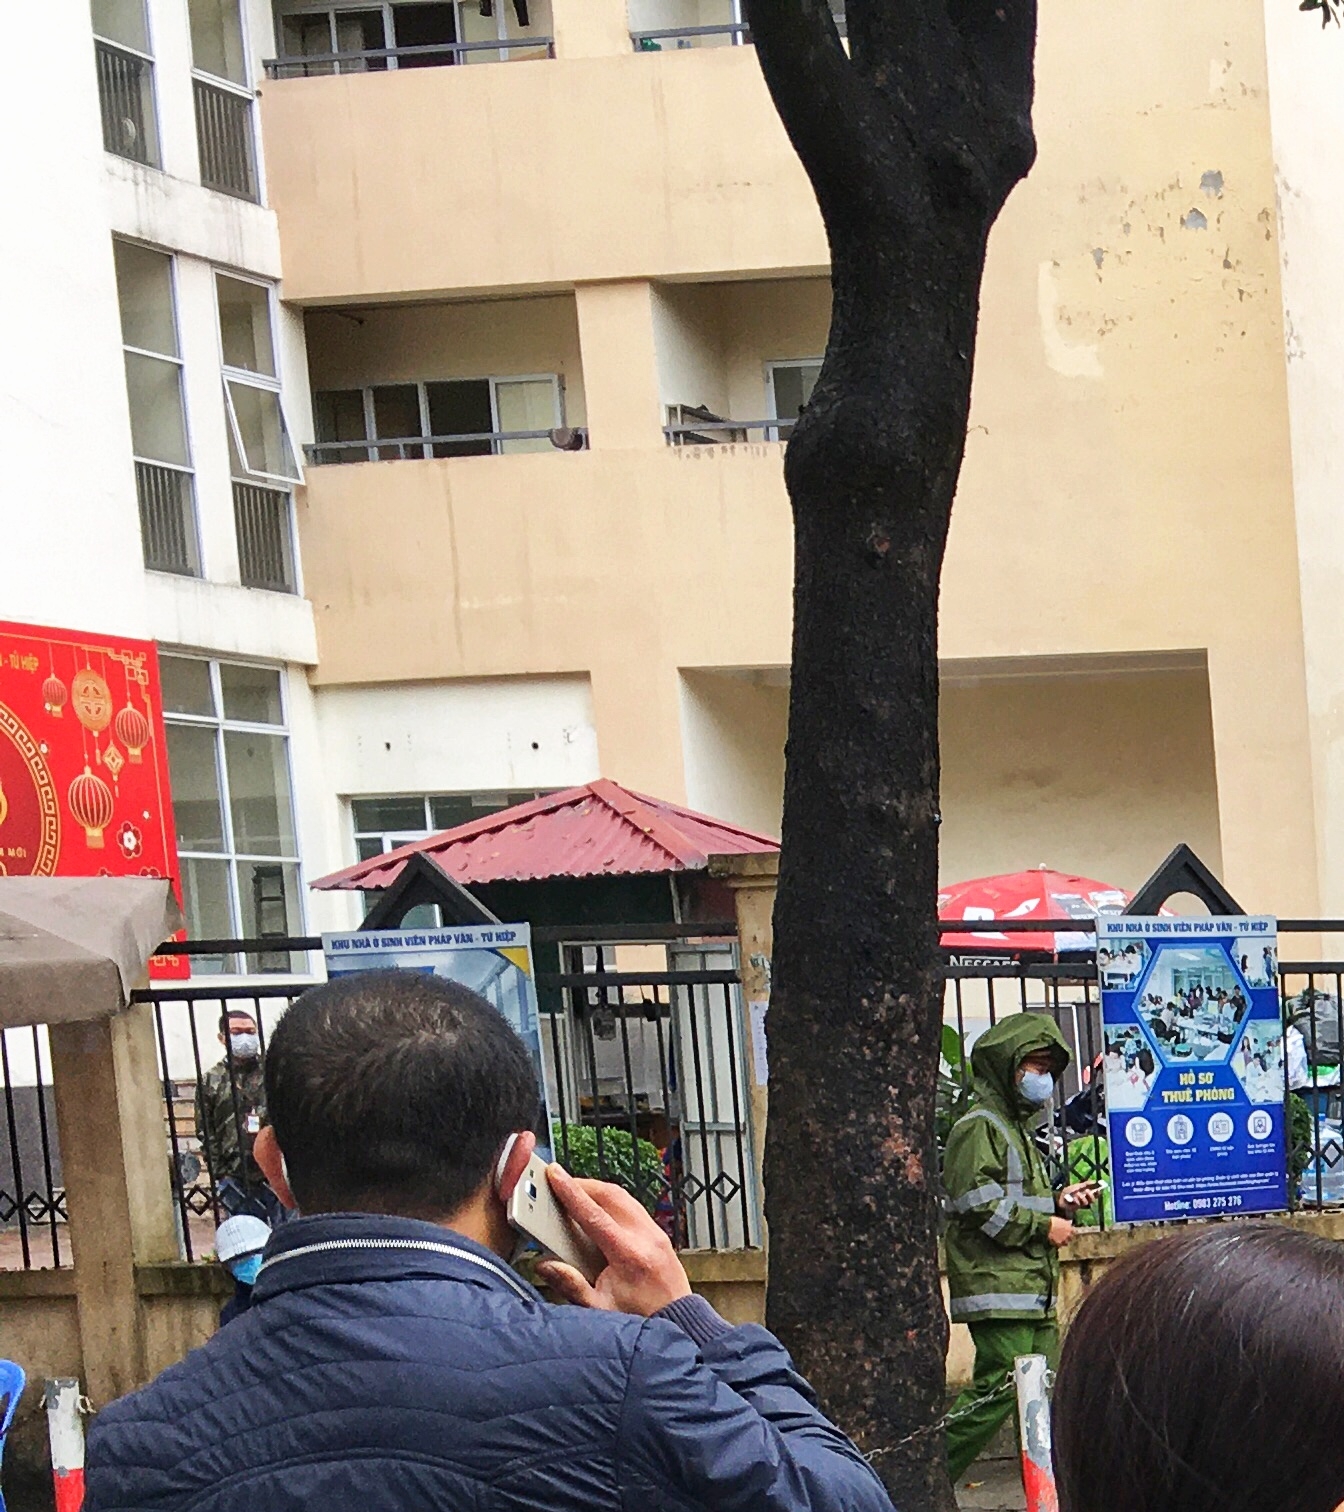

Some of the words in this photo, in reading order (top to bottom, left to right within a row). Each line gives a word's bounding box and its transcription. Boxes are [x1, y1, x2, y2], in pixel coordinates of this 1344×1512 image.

[1107, 923, 1123, 932] KHU
[1152, 923, 1171, 932] SINH
[1173, 921, 1192, 932] VIÊN
[331, 939, 350, 950] KHU
[351, 937, 371, 949] NHÀ
[381, 937, 403, 948] SINH
[404, 934, 426, 946] VIÊN
[428, 933, 452, 945] PHÁP
[453, 932, 473, 944] VÂN
[1161, 1087, 1193, 1103] THUÊ
